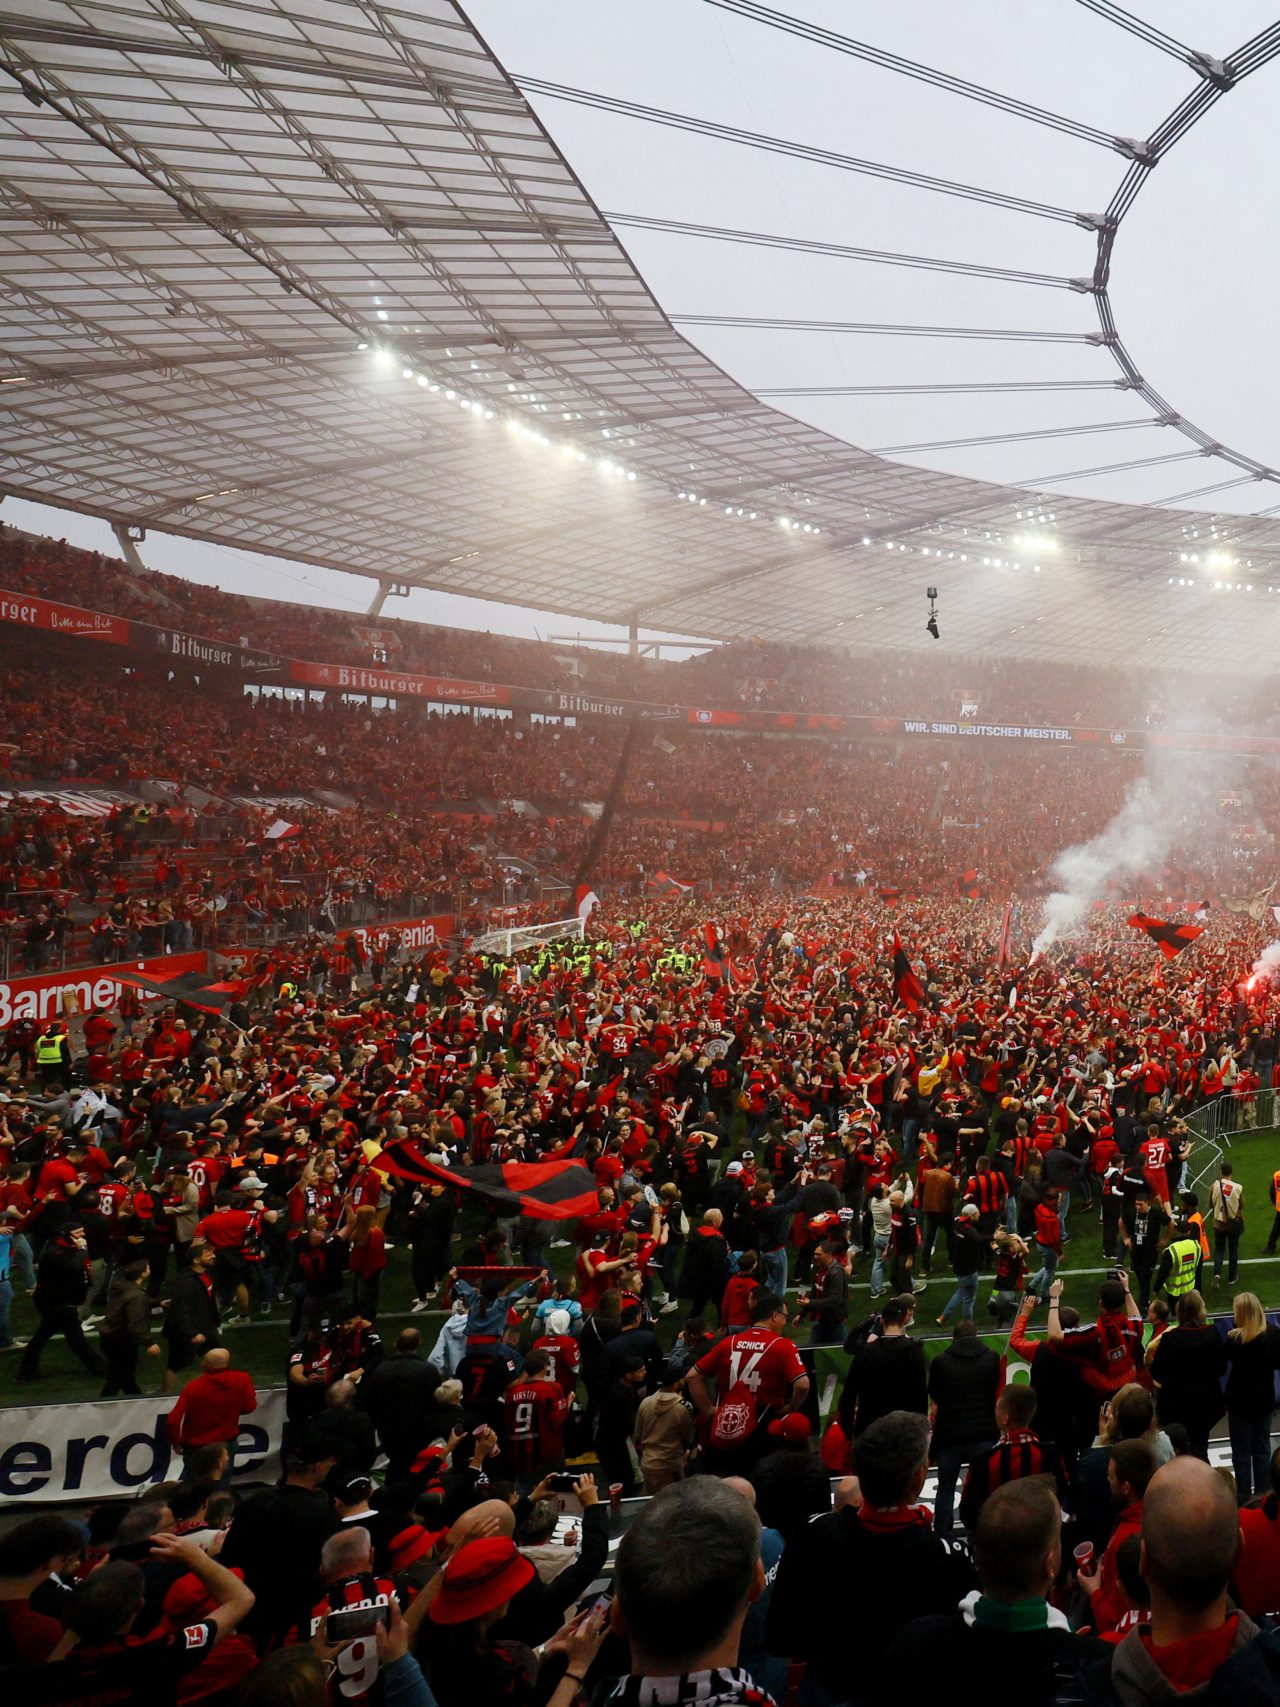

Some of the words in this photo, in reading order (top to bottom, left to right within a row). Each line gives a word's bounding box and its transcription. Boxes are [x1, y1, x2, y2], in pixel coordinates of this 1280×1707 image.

[172, 632, 233, 665] Bitburger
[338, 668, 424, 694] Bitburger
[559, 694, 625, 716] Bitburger
[904, 721, 930, 733] WIR.
[931, 723, 957, 735] SIND
[958, 725, 1021, 738] DEUTSCHER
[1023, 728, 1072, 741] MEISTER.
[612, 1036, 628, 1050] 34
[711, 1067, 728, 1083] 20
[1148, 1146, 1165, 1164] 27
[736, 1340, 767, 1351] SCHICK
[729, 1351, 762, 1393] 14
[514, 1402, 533, 1433] 9
[337, 1635, 380, 1698] 9
